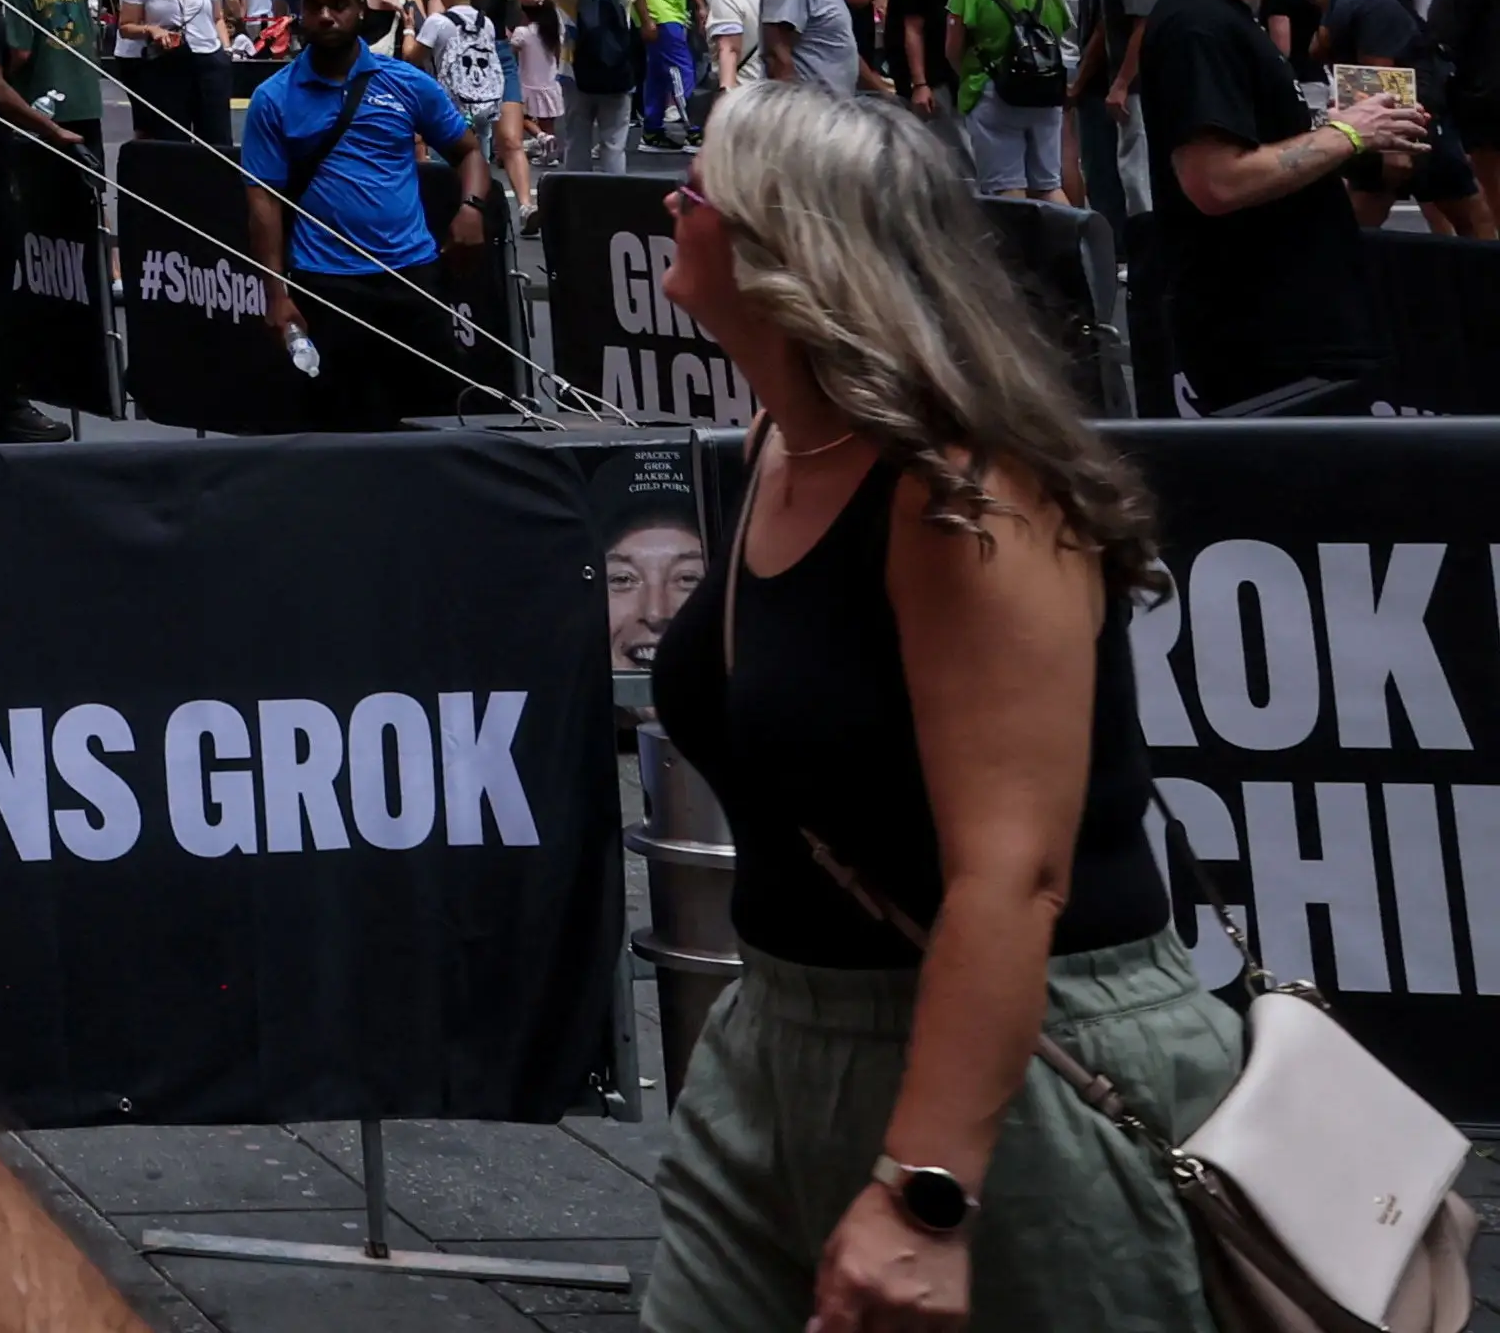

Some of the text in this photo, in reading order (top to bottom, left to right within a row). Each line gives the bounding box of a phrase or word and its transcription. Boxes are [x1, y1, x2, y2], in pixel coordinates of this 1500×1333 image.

[24, 232, 90, 306] GROK
[643, 462, 672, 471] GROK
[634, 472, 684, 481] MAKES AI
[628, 482, 660, 493] CHILD
[164, 688, 541, 859] GROK
